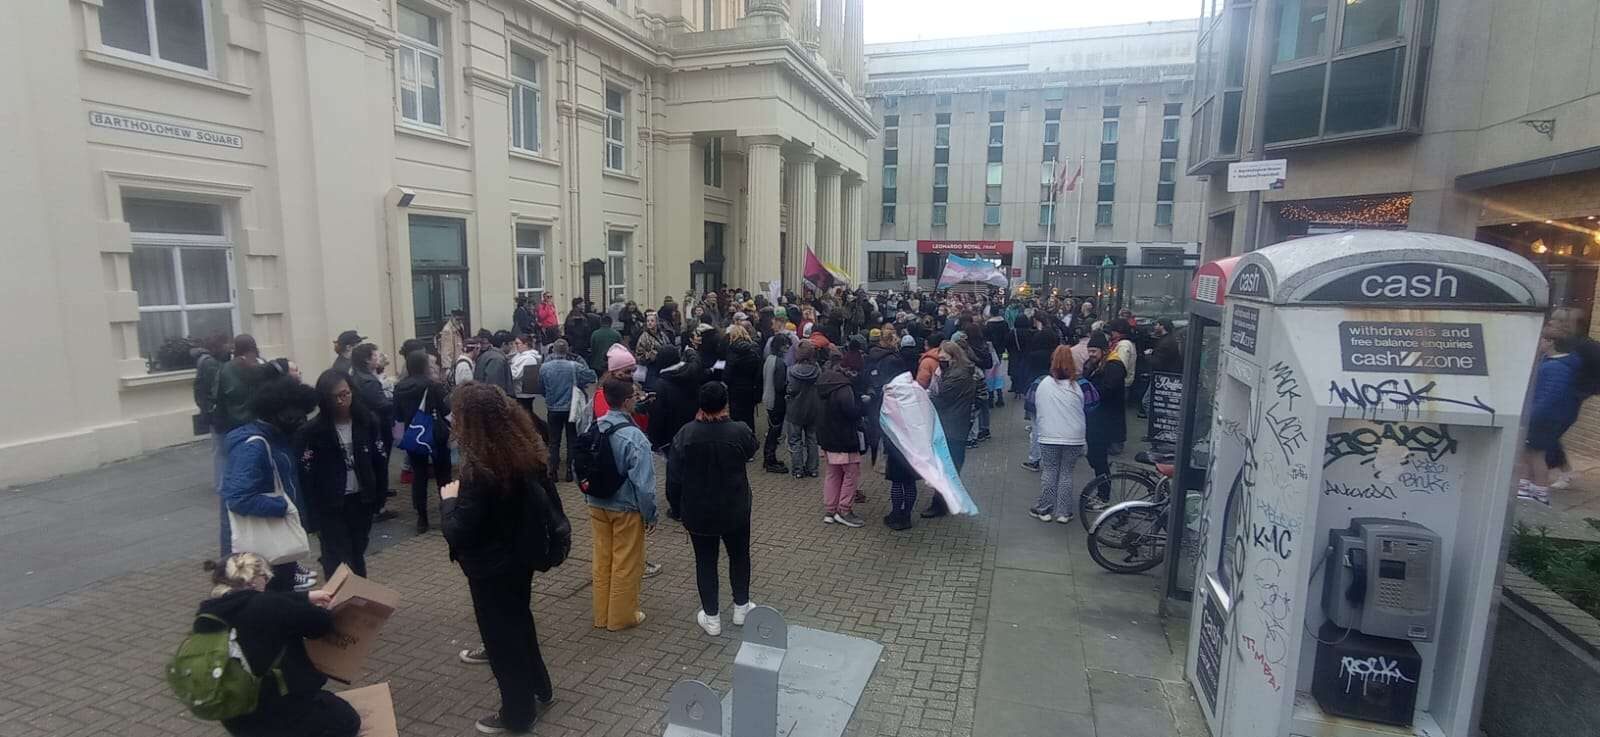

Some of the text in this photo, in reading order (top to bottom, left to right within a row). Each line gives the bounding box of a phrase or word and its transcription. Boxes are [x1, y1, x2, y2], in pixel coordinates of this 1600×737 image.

[94, 114, 240, 146] BARTHOLOMEW SQUARE
[1239, 267, 1260, 291] cash
[1361, 269, 1459, 298] cash
[1349, 326, 1471, 338] withdrawals and
[1351, 337, 1474, 349] free balance enquiries
